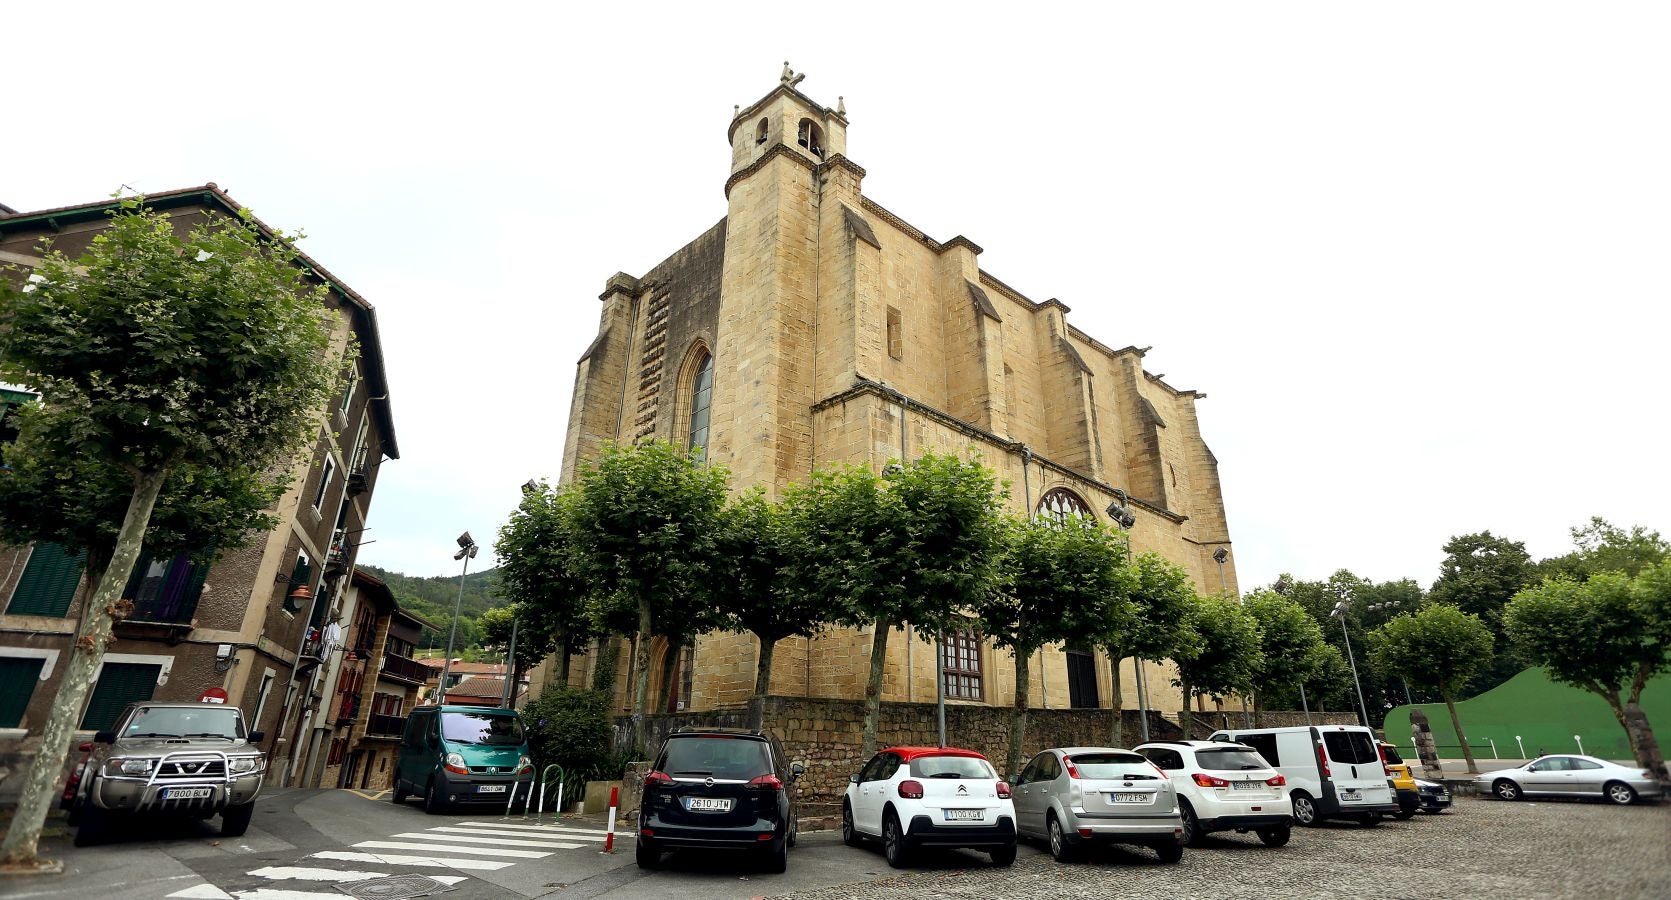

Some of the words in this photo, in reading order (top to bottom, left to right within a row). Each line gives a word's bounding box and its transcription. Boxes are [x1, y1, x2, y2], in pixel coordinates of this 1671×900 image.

[1115, 793, 1133, 802] 0772
[691, 799, 712, 808] 2610
[950, 810, 967, 818] 1100
